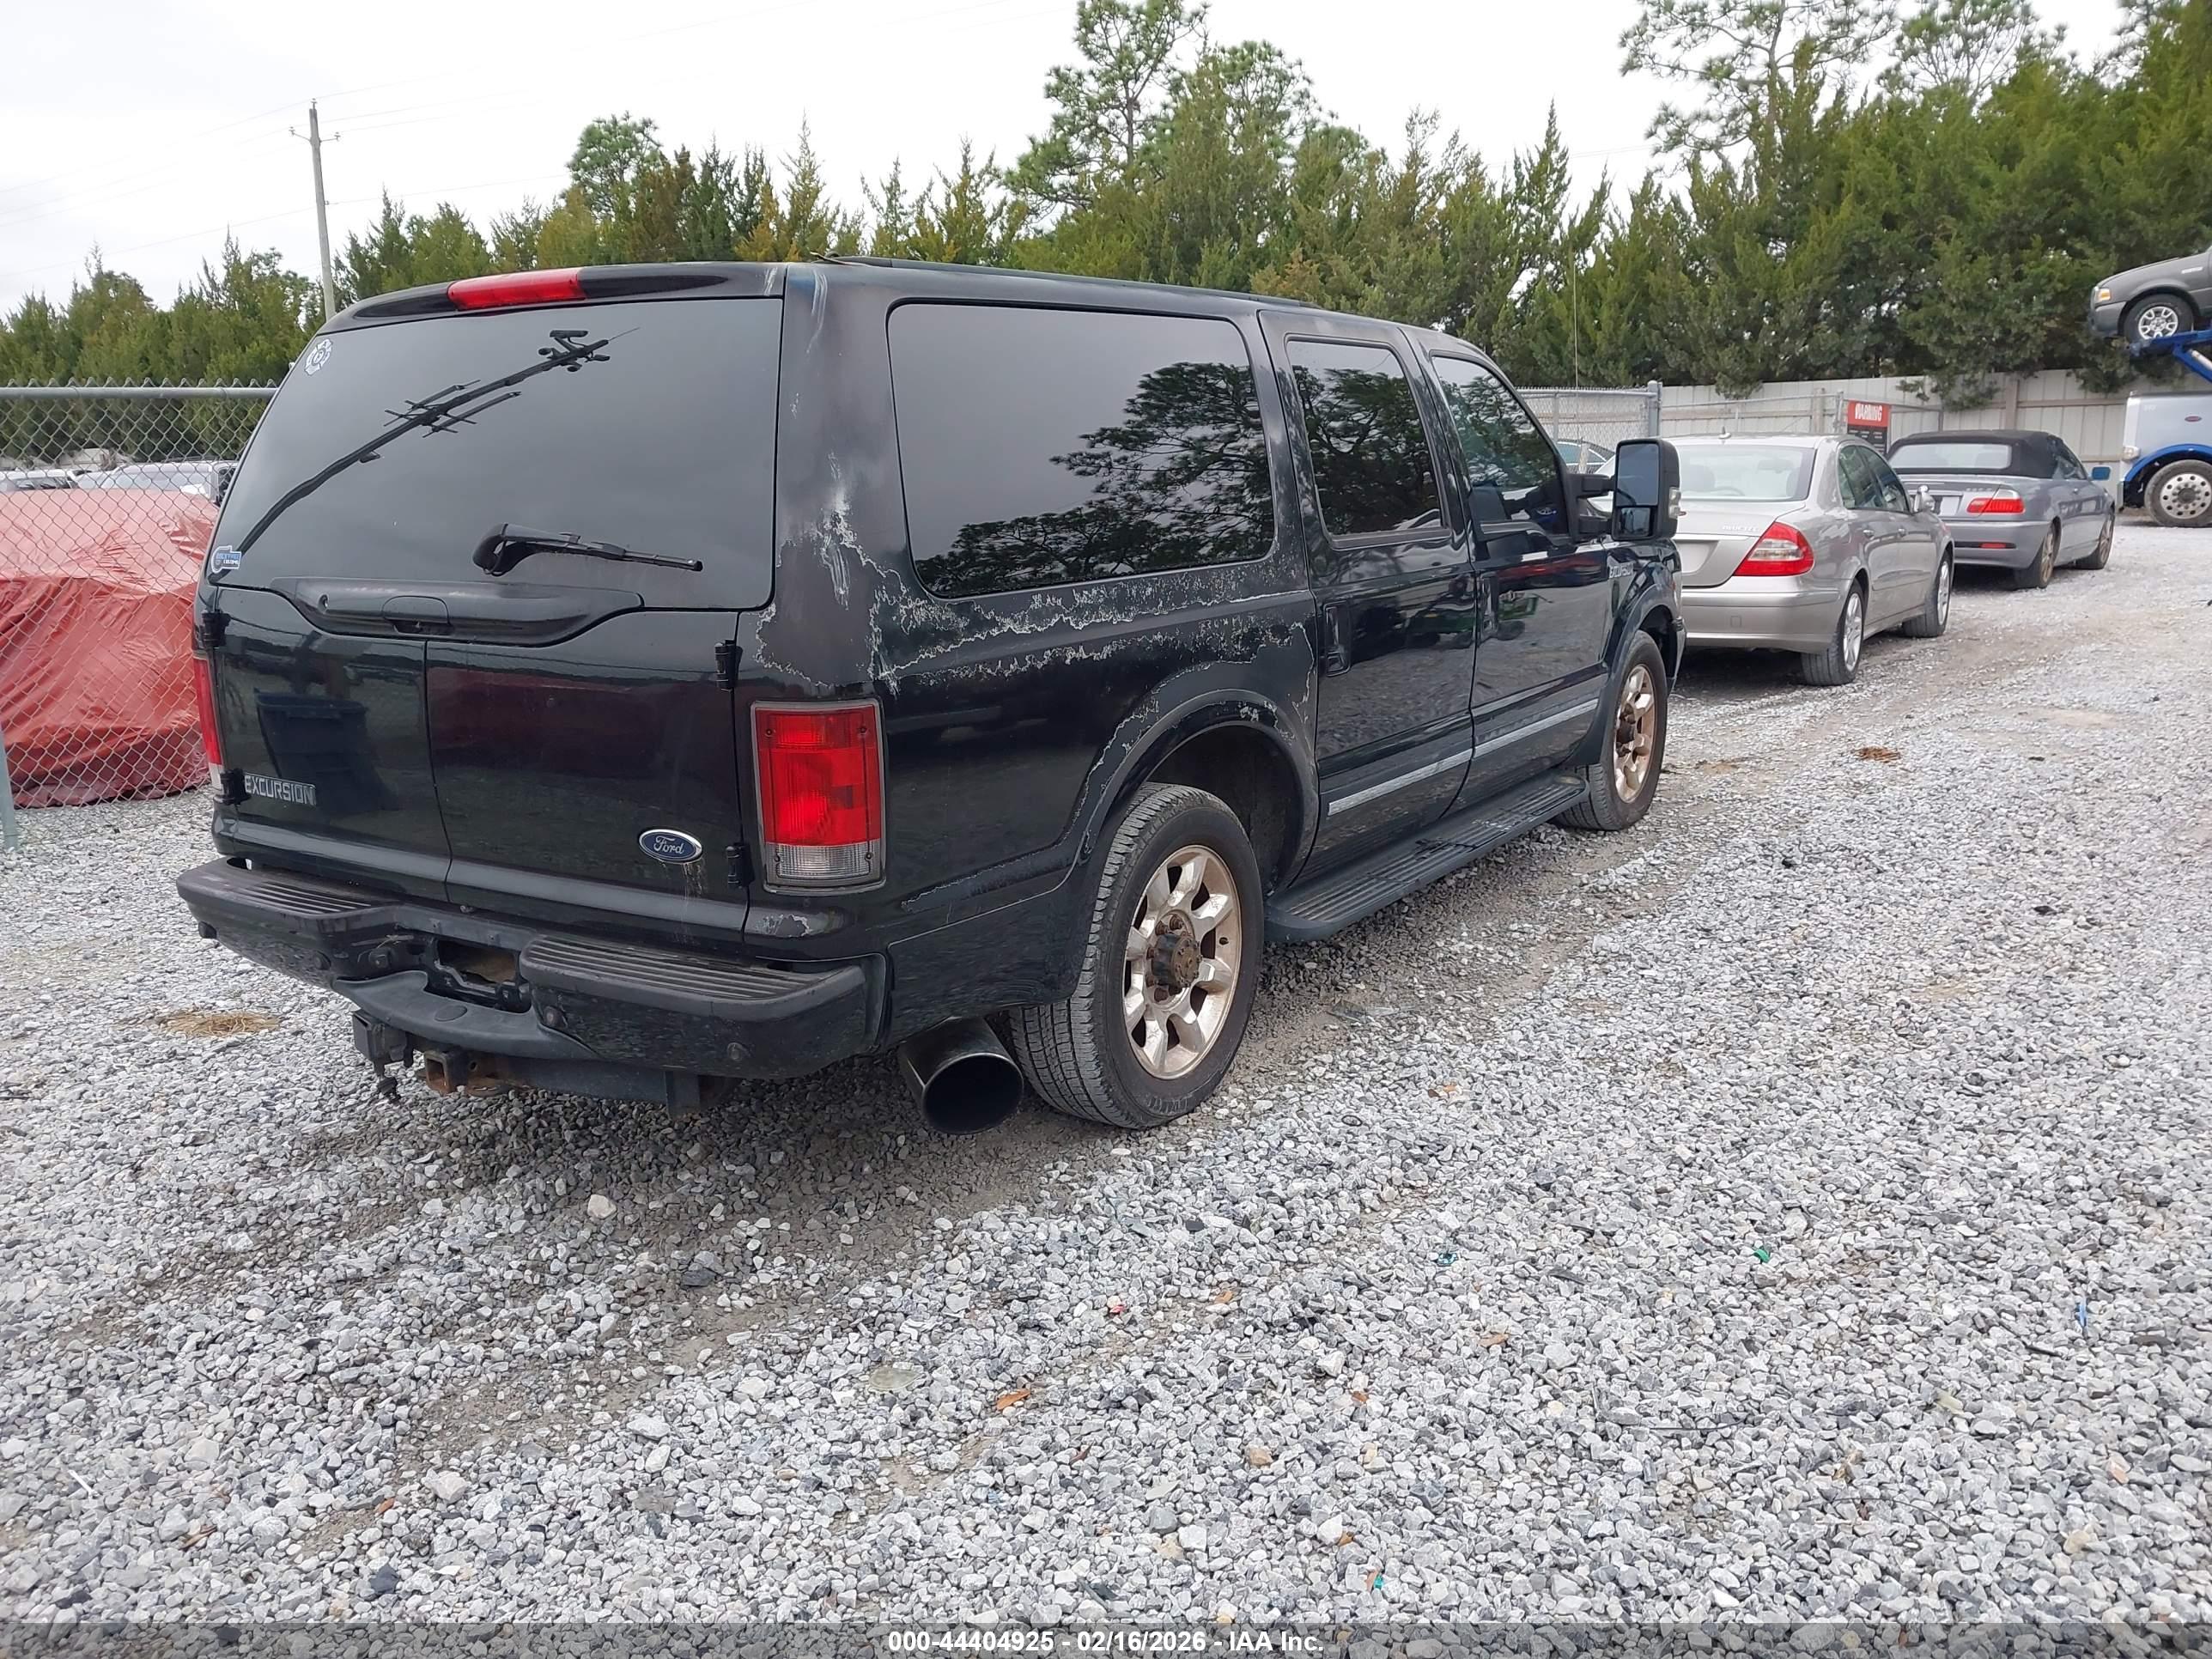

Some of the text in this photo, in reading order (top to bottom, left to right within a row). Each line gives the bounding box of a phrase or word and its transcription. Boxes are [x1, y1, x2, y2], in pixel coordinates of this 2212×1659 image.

[1855, 403, 1883, 422] WARNING
[244, 775, 317, 805] EXCURSION
[653, 836, 685, 854] Ford
